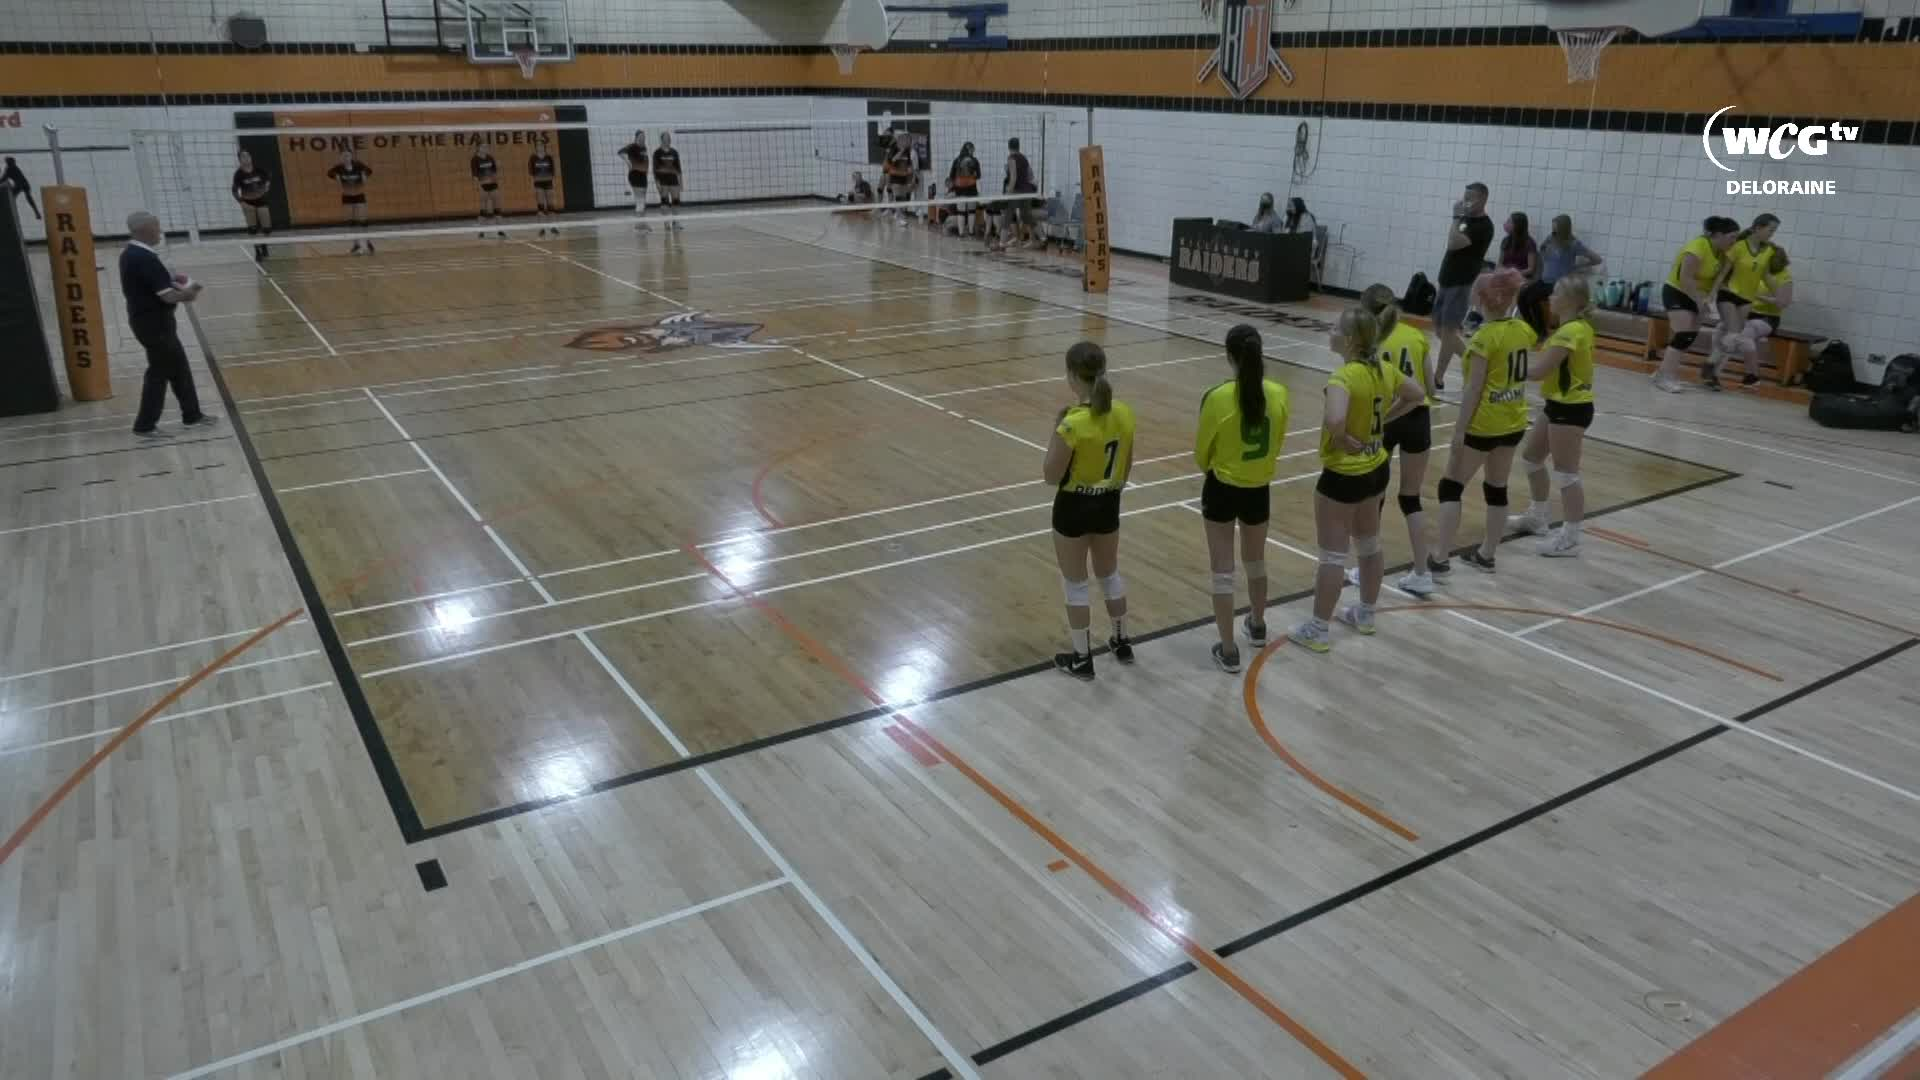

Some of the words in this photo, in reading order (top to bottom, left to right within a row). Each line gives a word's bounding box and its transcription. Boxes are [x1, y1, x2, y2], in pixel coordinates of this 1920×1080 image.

[289, 136, 365, 151] HOME
[373, 134, 400, 149] OF
[408, 134, 447, 149] THE
[452, 130, 550, 147] RAIDERS
[1091, 165, 1106, 271] RAIDERS
[1178, 246, 1260, 282] RAIDERS
[55, 213, 91, 368] RAIDERS
[1508, 348, 1527, 384] 10
[1241, 412, 1270, 462] 9
[1104, 440, 1119, 480] 7
